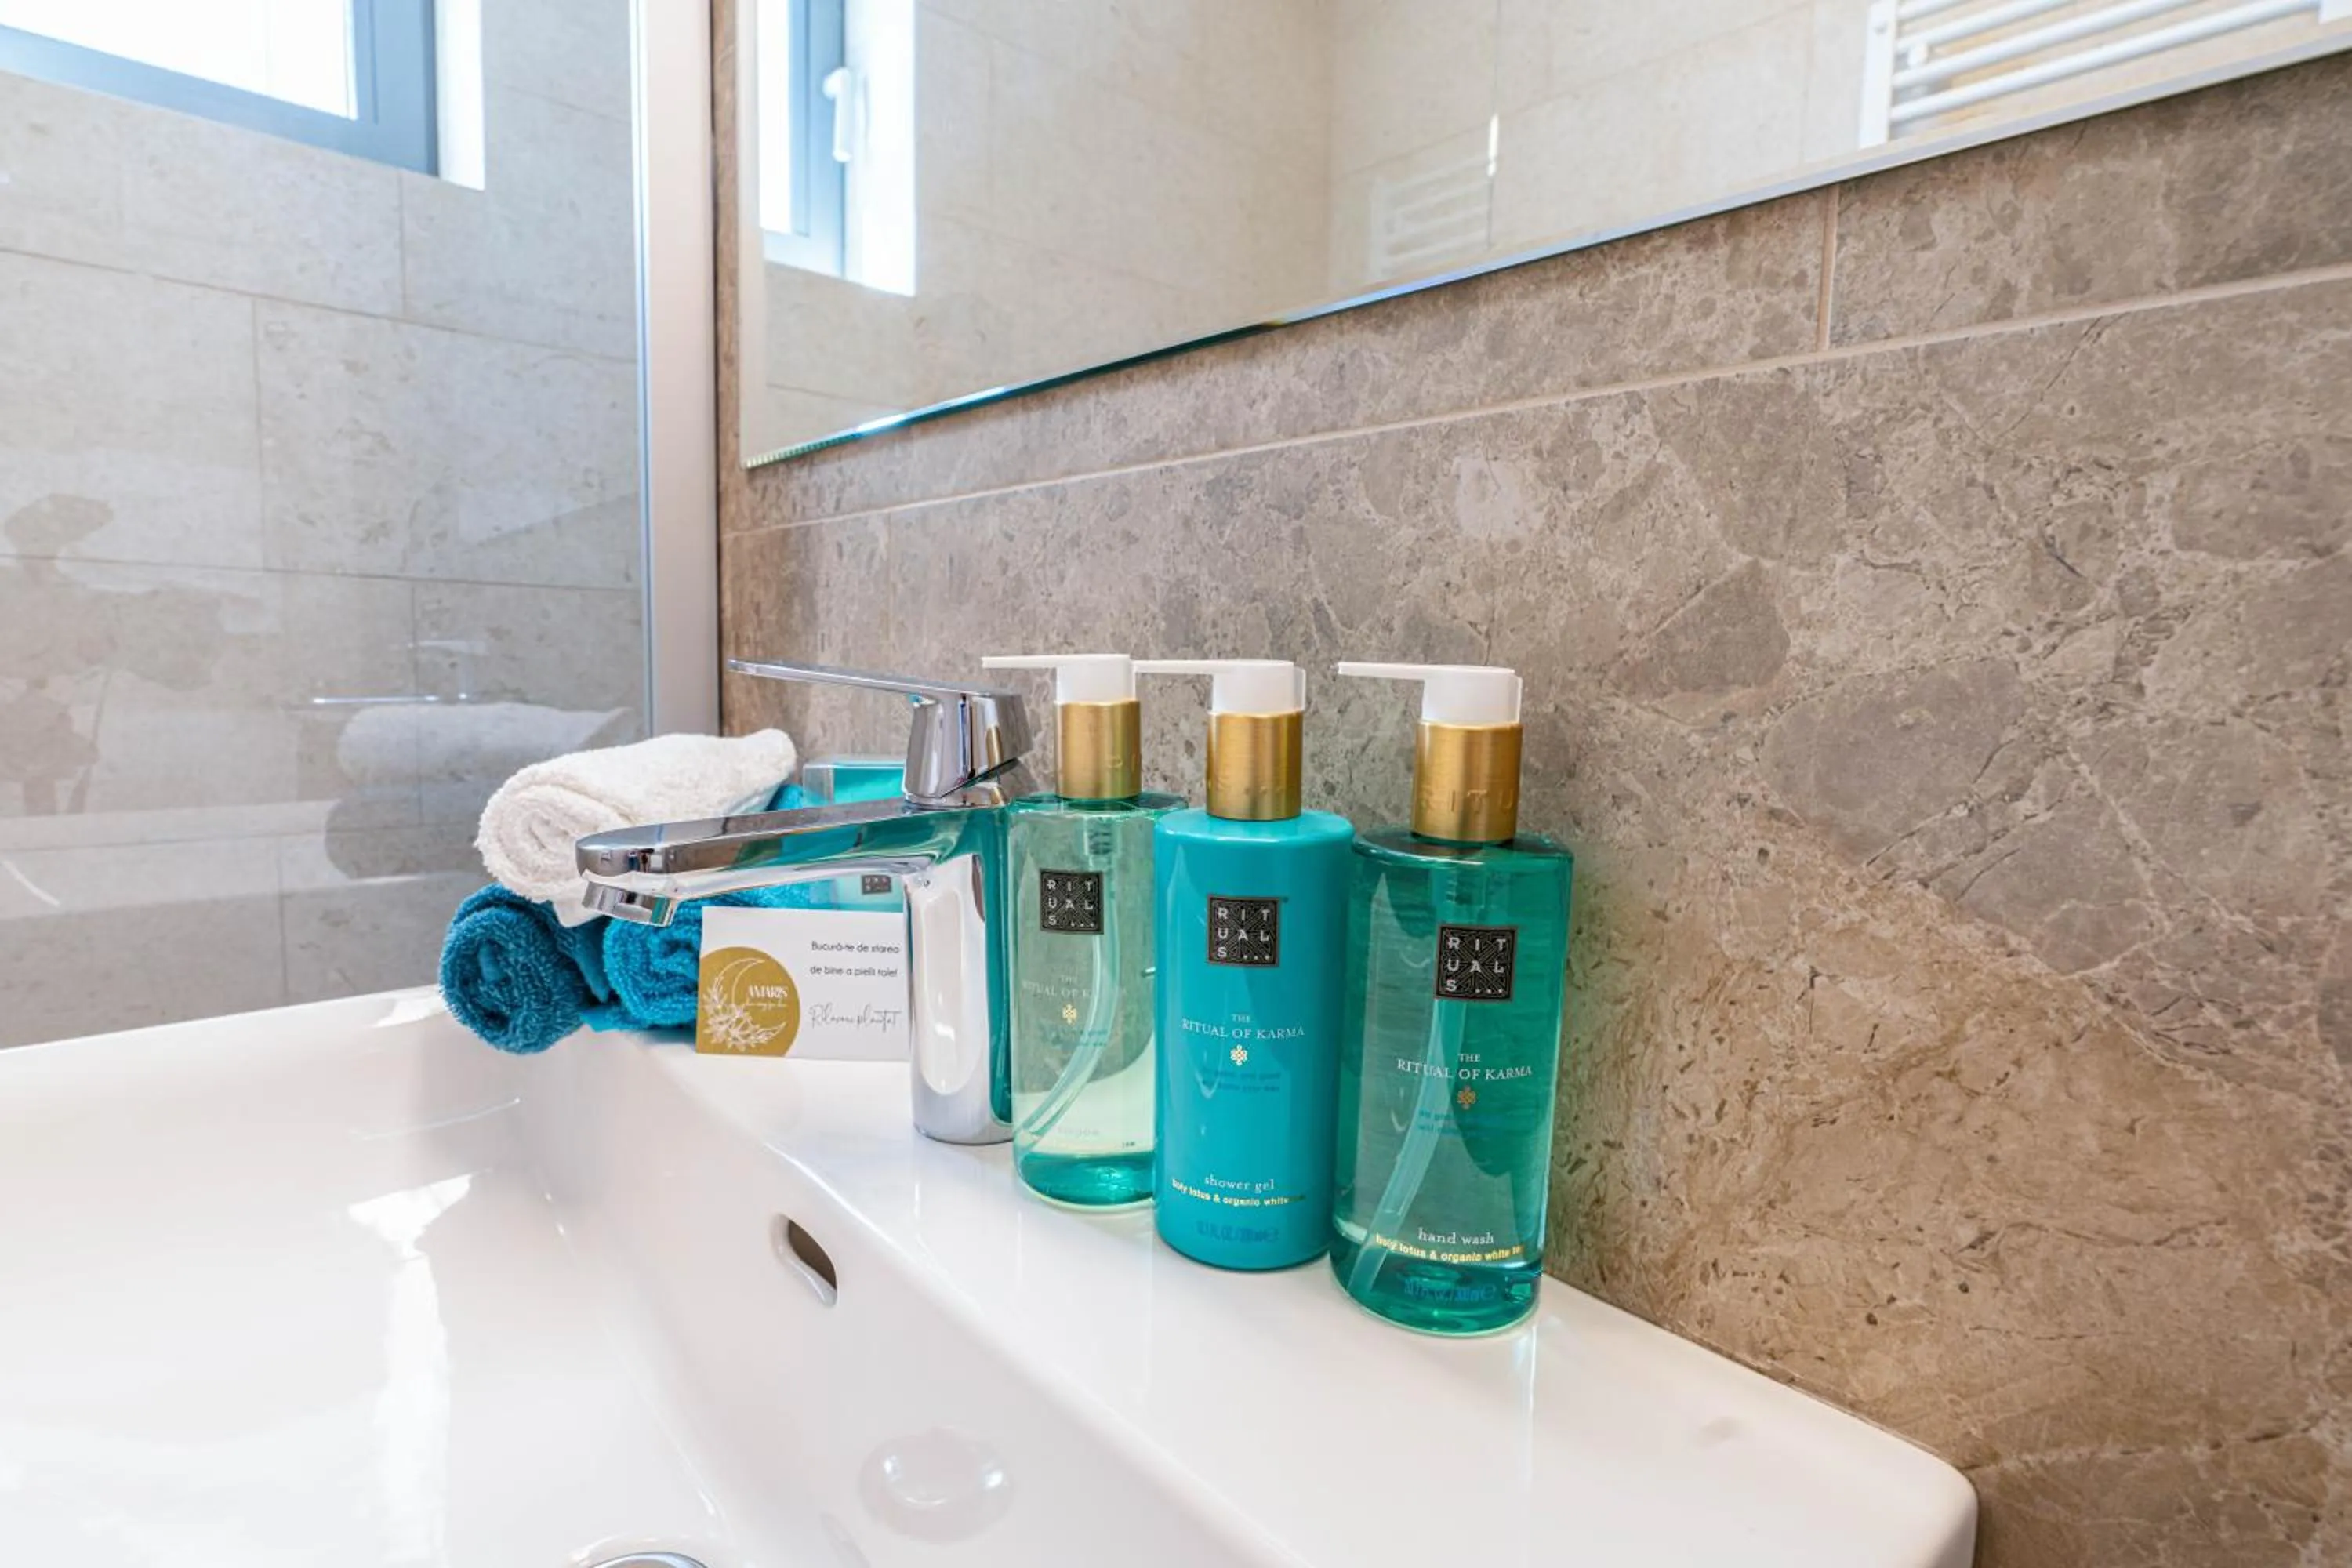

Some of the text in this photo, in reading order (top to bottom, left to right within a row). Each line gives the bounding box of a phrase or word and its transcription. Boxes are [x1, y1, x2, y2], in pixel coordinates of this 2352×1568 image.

[856, 944, 869, 953] de
[810, 965, 822, 975] de
[824, 966, 844, 975] bine
[1231, 1014, 1251, 1022] THE
[1181, 1018, 1305, 1040] RITUAL OF KARMA
[1457, 1053, 1481, 1062] THE
[1397, 1058, 1533, 1080] RITUAL OF KARMA
[1204, 1174, 1275, 1193] shower gel
[1213, 1194, 1221, 1203] &
[1417, 1227, 1494, 1245] hand wash
[1399, 1243, 1426, 1259] lotus
[1429, 1250, 1438, 1261] &
[1440, 1252, 1482, 1265] organic
